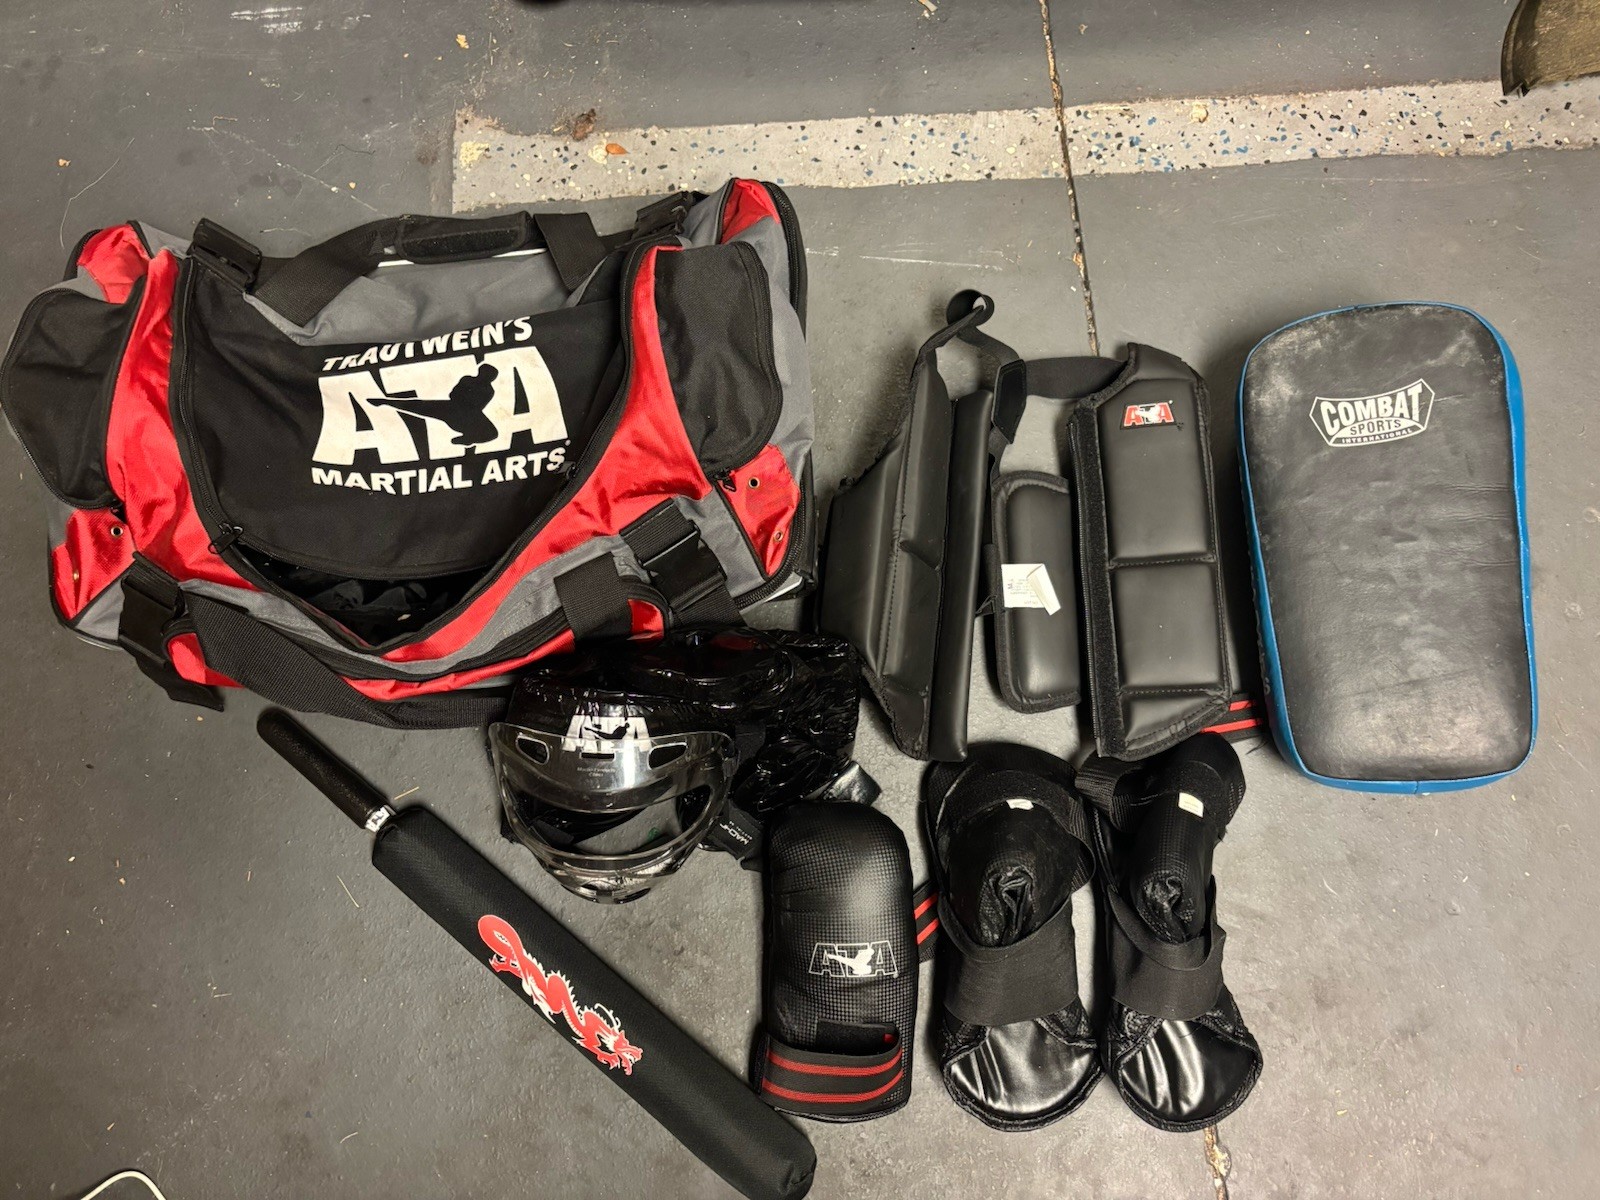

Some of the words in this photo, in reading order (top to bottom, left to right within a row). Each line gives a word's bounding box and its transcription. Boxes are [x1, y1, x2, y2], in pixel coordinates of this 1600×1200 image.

[312, 346, 568, 465] ATA
[1124, 402, 1174, 427] ATA
[1320, 383, 1423, 436] COMBAT
[1341, 428, 1413, 444] INTERNATIONAL
[1350, 419, 1402, 436] SPORTS
[311, 466, 473, 496] MARTIAL
[481, 447, 566, 485] ARTS
[562, 714, 651, 752] ATA
[809, 940, 898, 977] ATA
